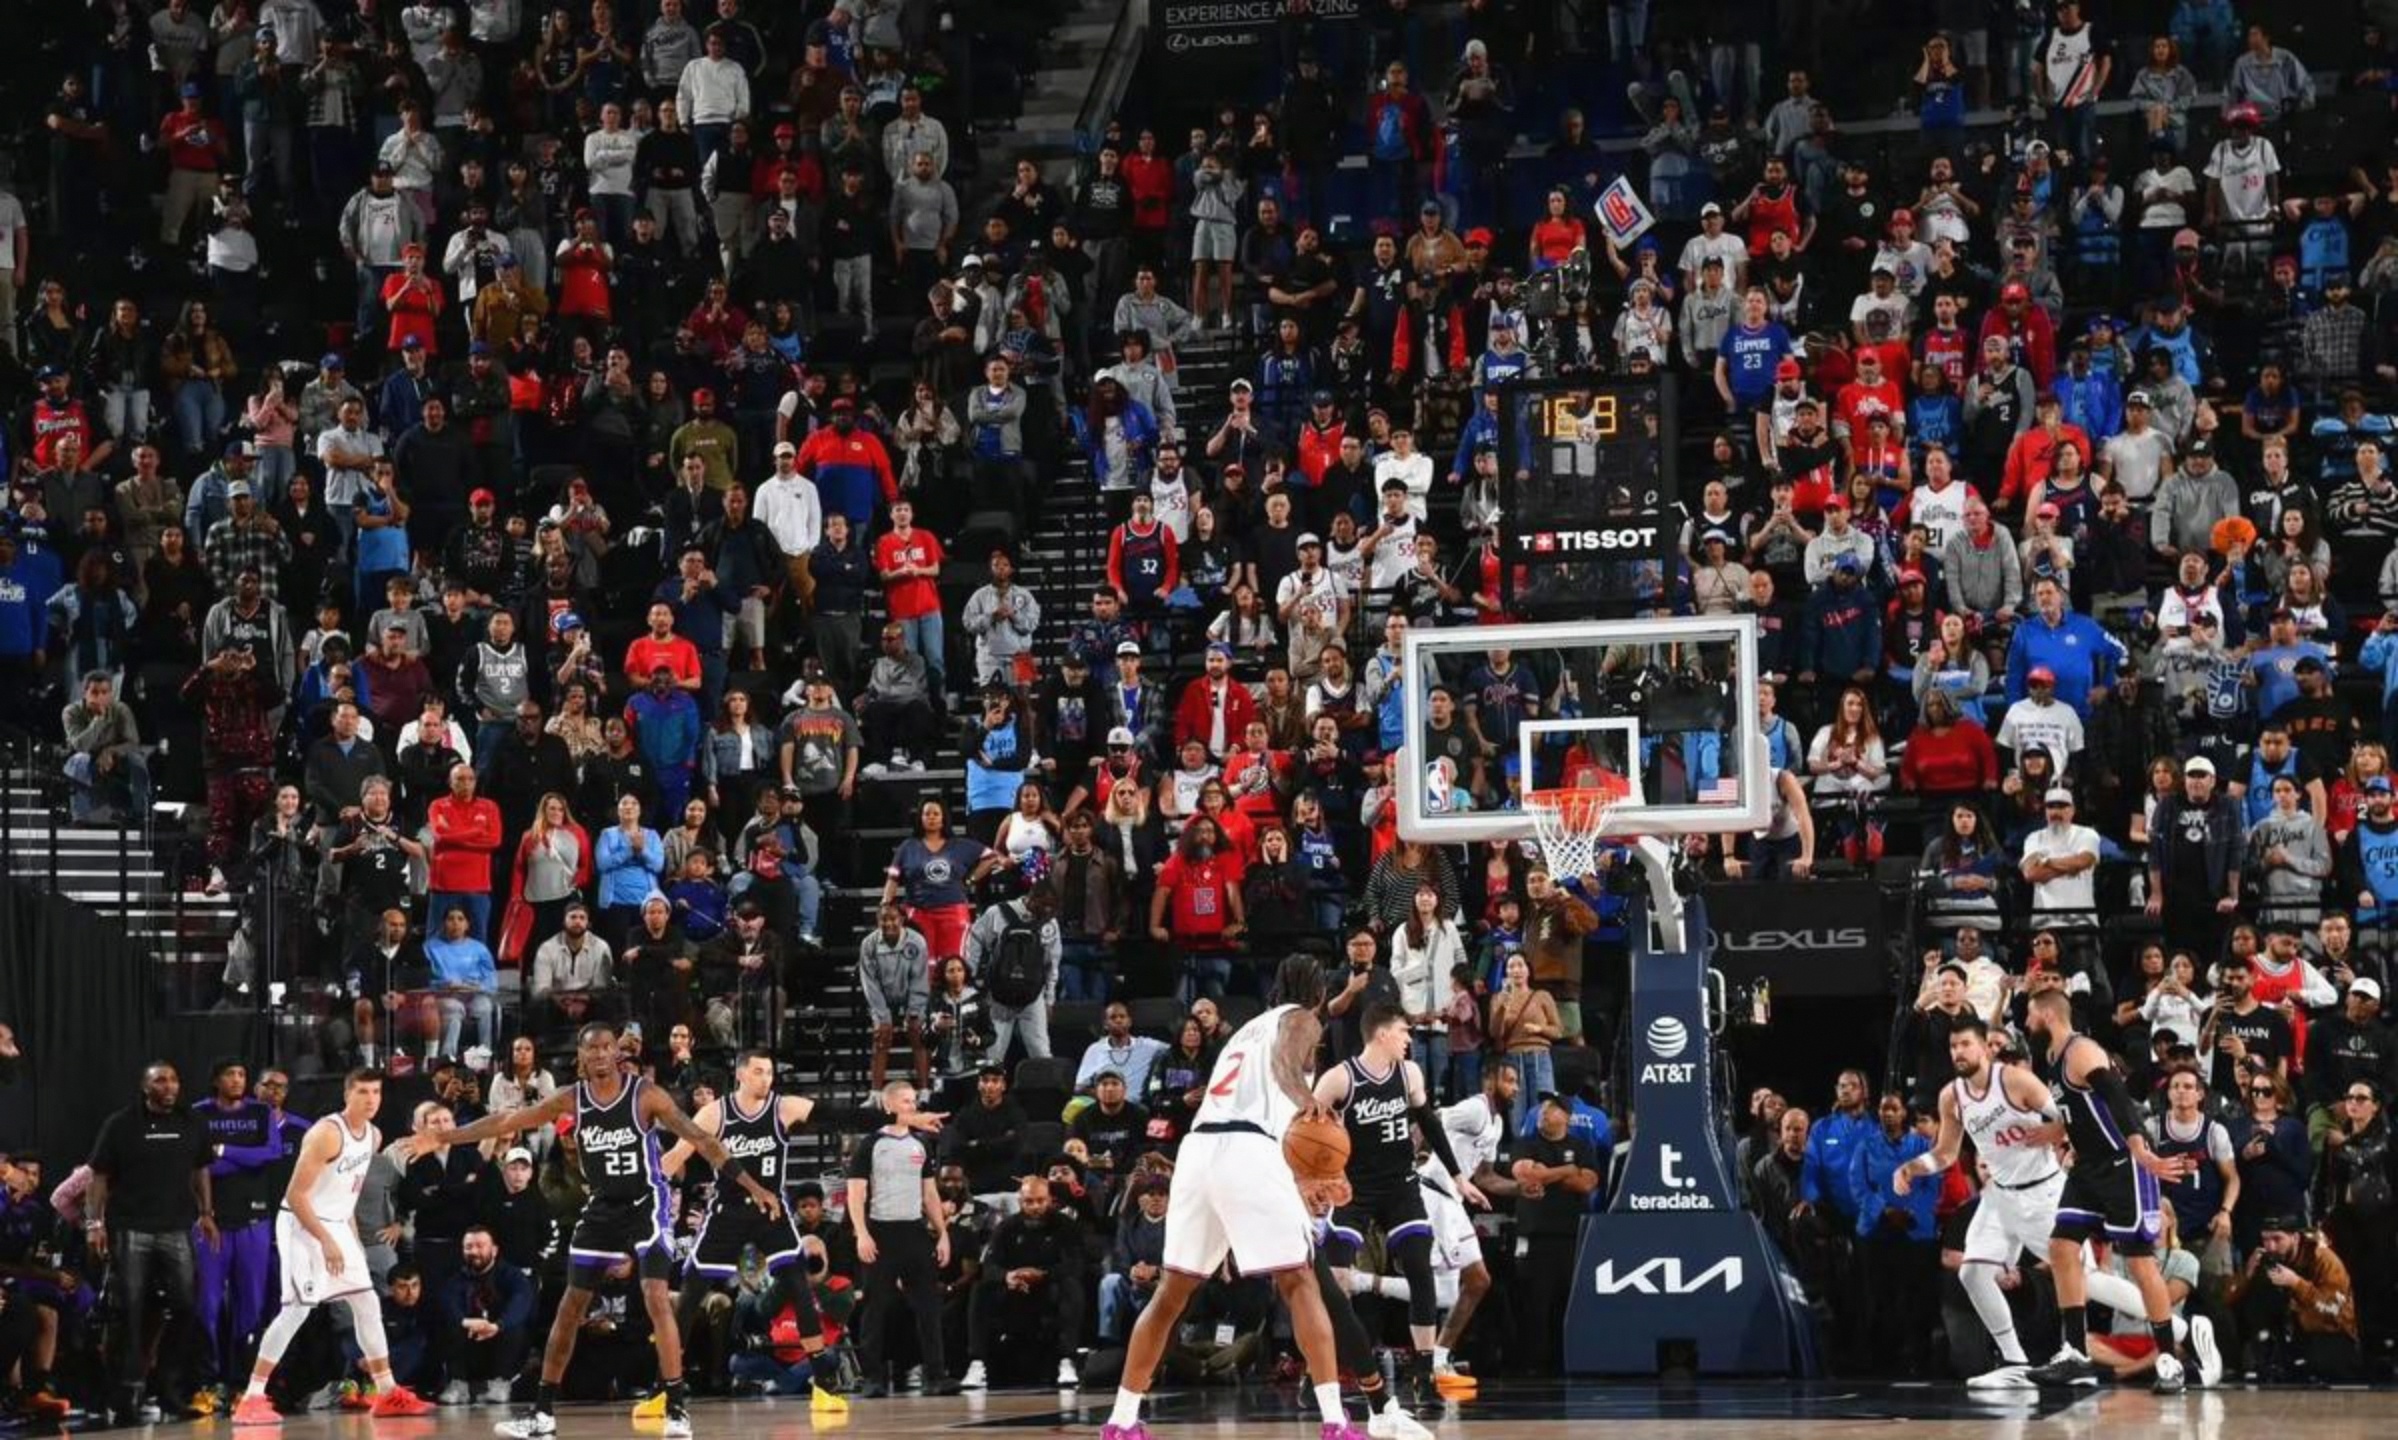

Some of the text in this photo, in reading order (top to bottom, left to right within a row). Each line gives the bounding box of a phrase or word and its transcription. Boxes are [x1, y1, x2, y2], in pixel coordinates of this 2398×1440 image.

[1165, 1, 1271, 25] EXPERIENCE
[1191, 35, 1259, 48] LEXUS
[1734, 338, 1771, 353] CLIPPERS
[1743, 353, 1762, 369] 23
[2000, 405, 2010, 422] 2
[1556, 527, 1658, 550] TISSOT
[1926, 528, 1943, 548] 21
[1140, 559, 1159, 574] 32
[1909, 639, 1920, 656] 2
[486, 663, 522, 678] CLIPPERS
[501, 677, 512, 694] 2
[2357, 802, 2369, 820] 2
[374, 853, 386, 869] 2
[1722, 928, 1868, 951] LEXUS
[1210, 1052, 1245, 1096] 2
[1641, 1062, 1697, 1085] AT&T
[1353, 1096, 1407, 1125] Kings
[580, 1125, 638, 1154] Kings
[1380, 1116, 1409, 1143] 33
[1995, 1124, 2026, 1148] 40
[723, 1134, 777, 1158] Kings
[605, 1151, 639, 1177] 23
[761, 1155, 777, 1177] 8
[1660, 1143, 1697, 1189] t.
[1630, 1192, 1715, 1210] teradata.
